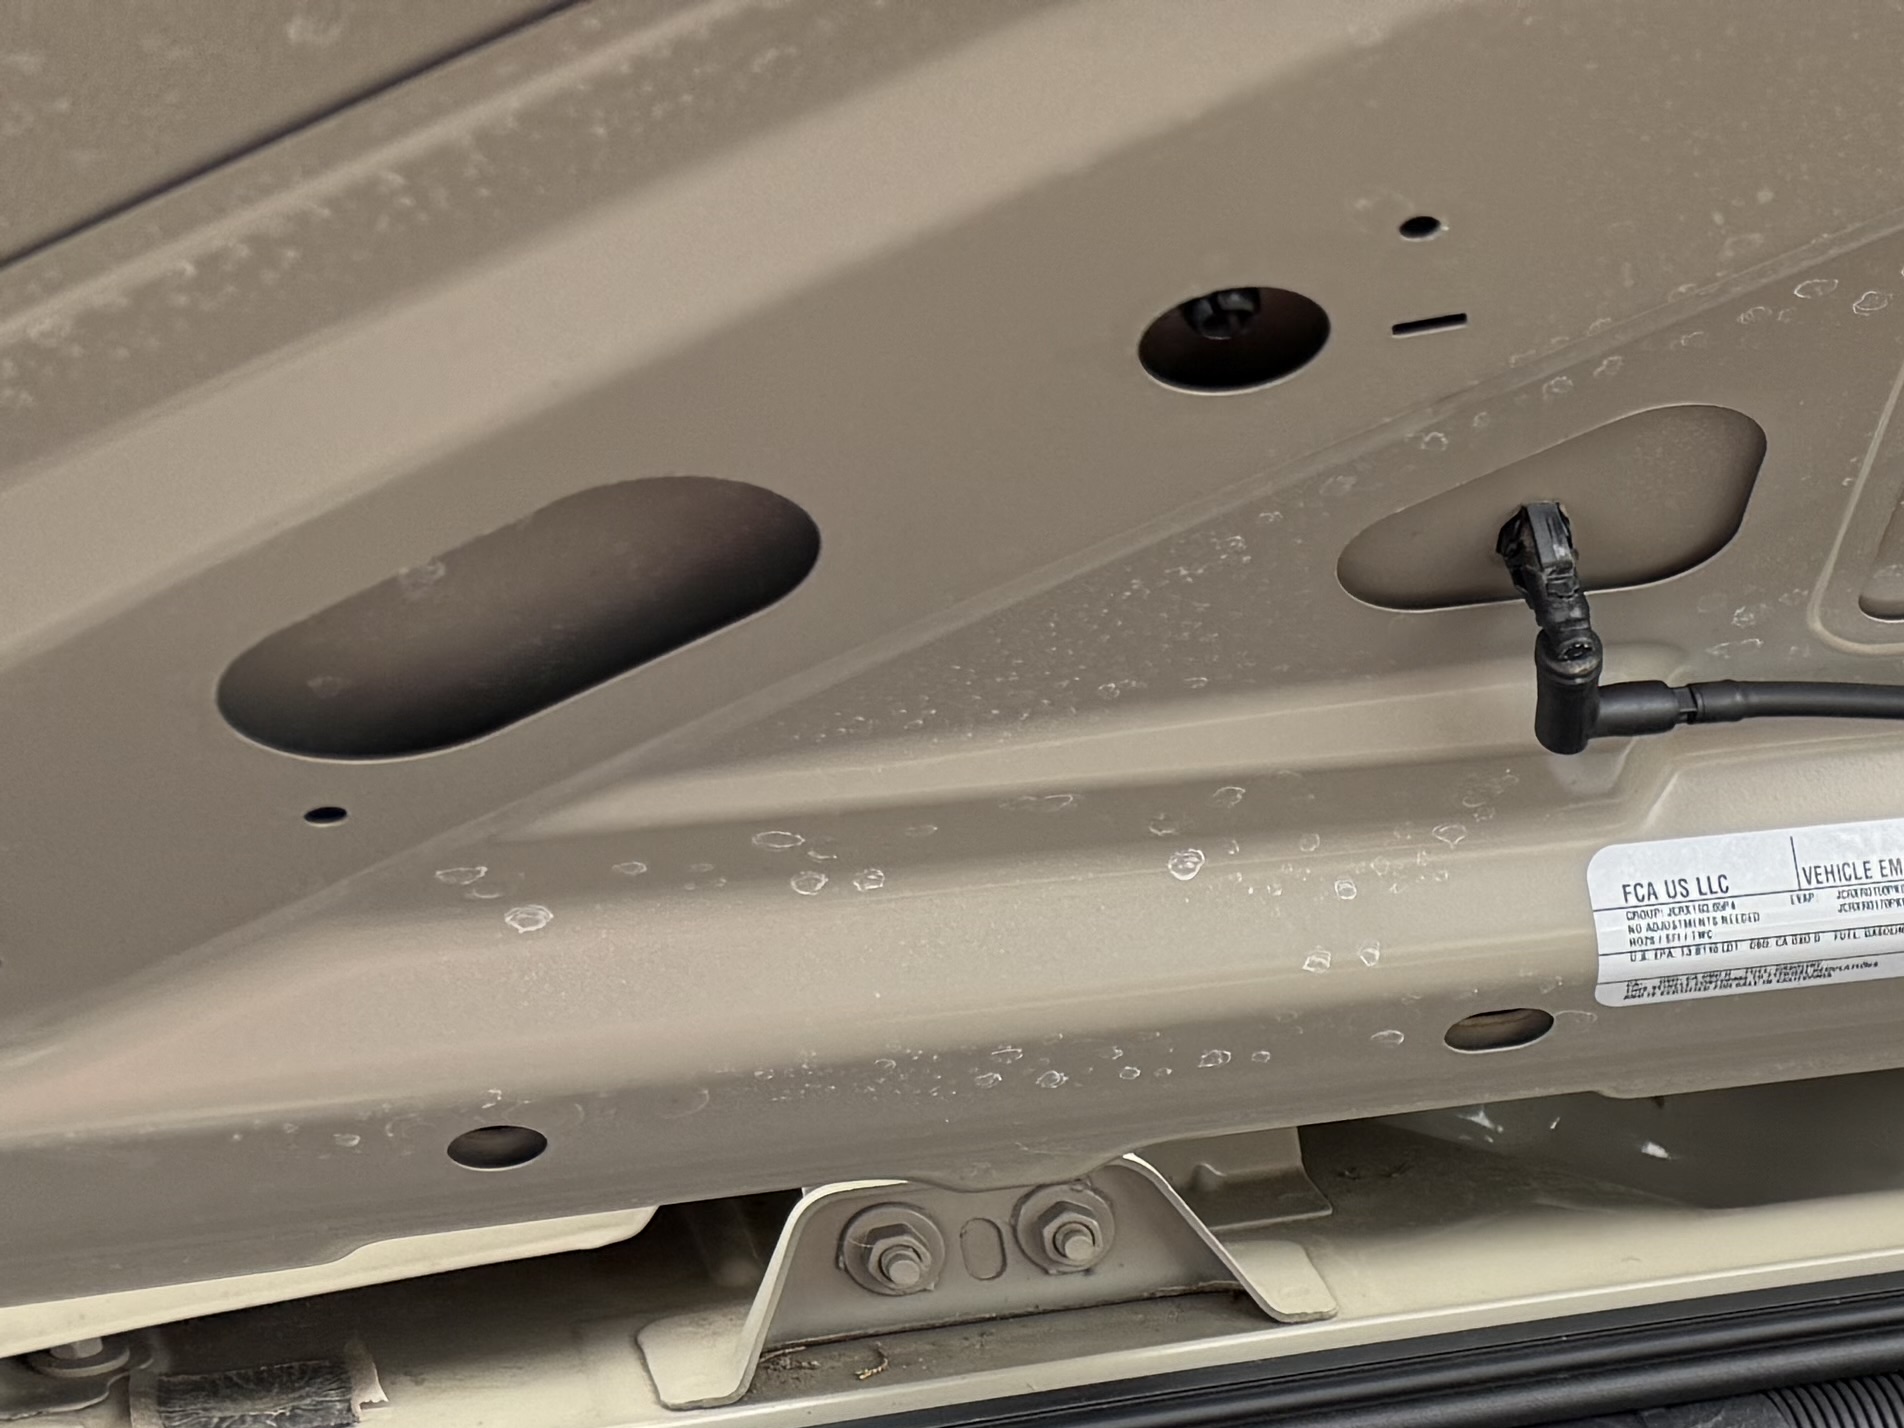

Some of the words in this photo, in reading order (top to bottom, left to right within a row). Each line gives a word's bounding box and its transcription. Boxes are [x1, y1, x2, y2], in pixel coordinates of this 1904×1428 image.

[1802, 860, 1873, 886] VEHICLE
[1622, 881, 1657, 904] FCA
[1665, 878, 1696, 900] US
[1698, 874, 1730, 896] LLC
